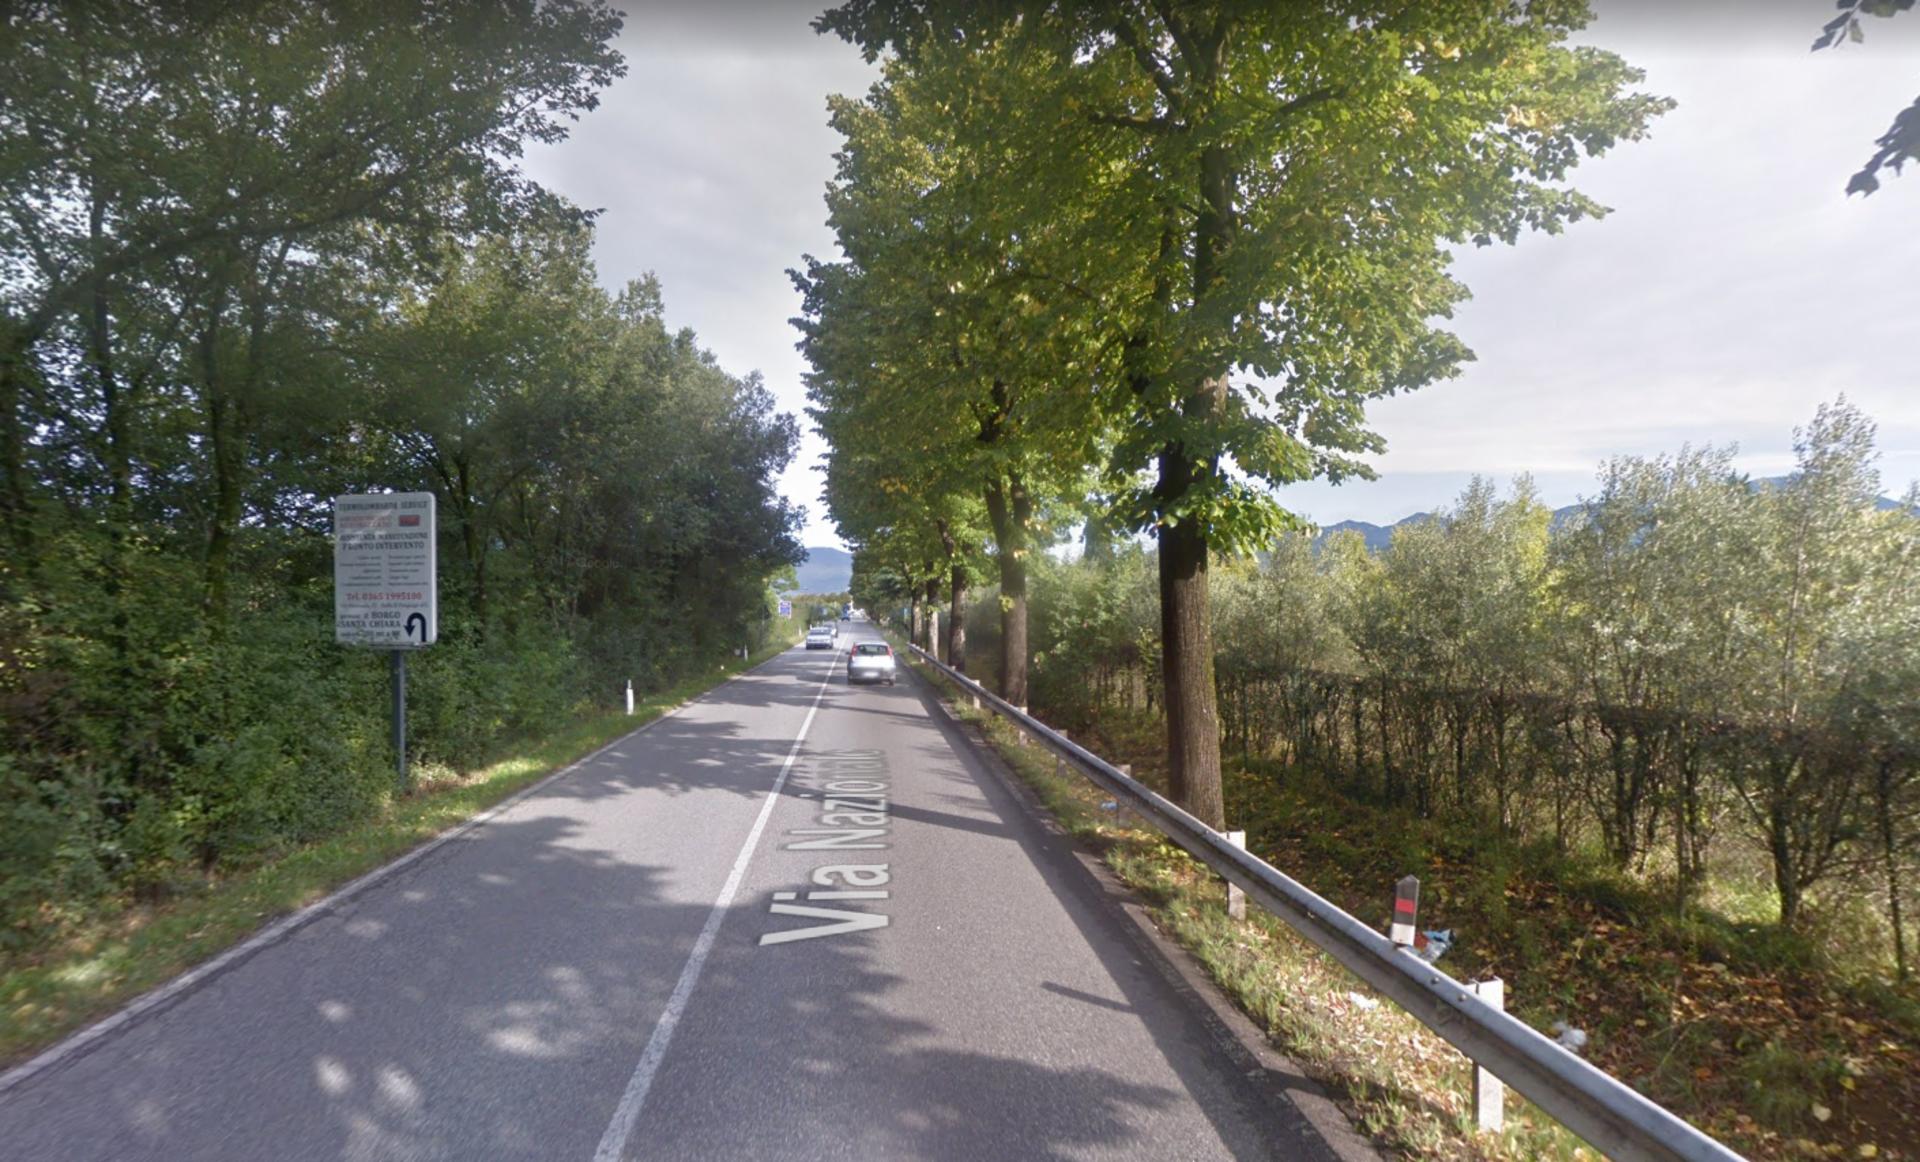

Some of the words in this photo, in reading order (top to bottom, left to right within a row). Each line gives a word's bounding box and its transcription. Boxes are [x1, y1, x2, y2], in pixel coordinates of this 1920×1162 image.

[371, 611, 401, 619] BORGO
[340, 620, 367, 628] SANTA
[369, 620, 401, 628] CHIARA
